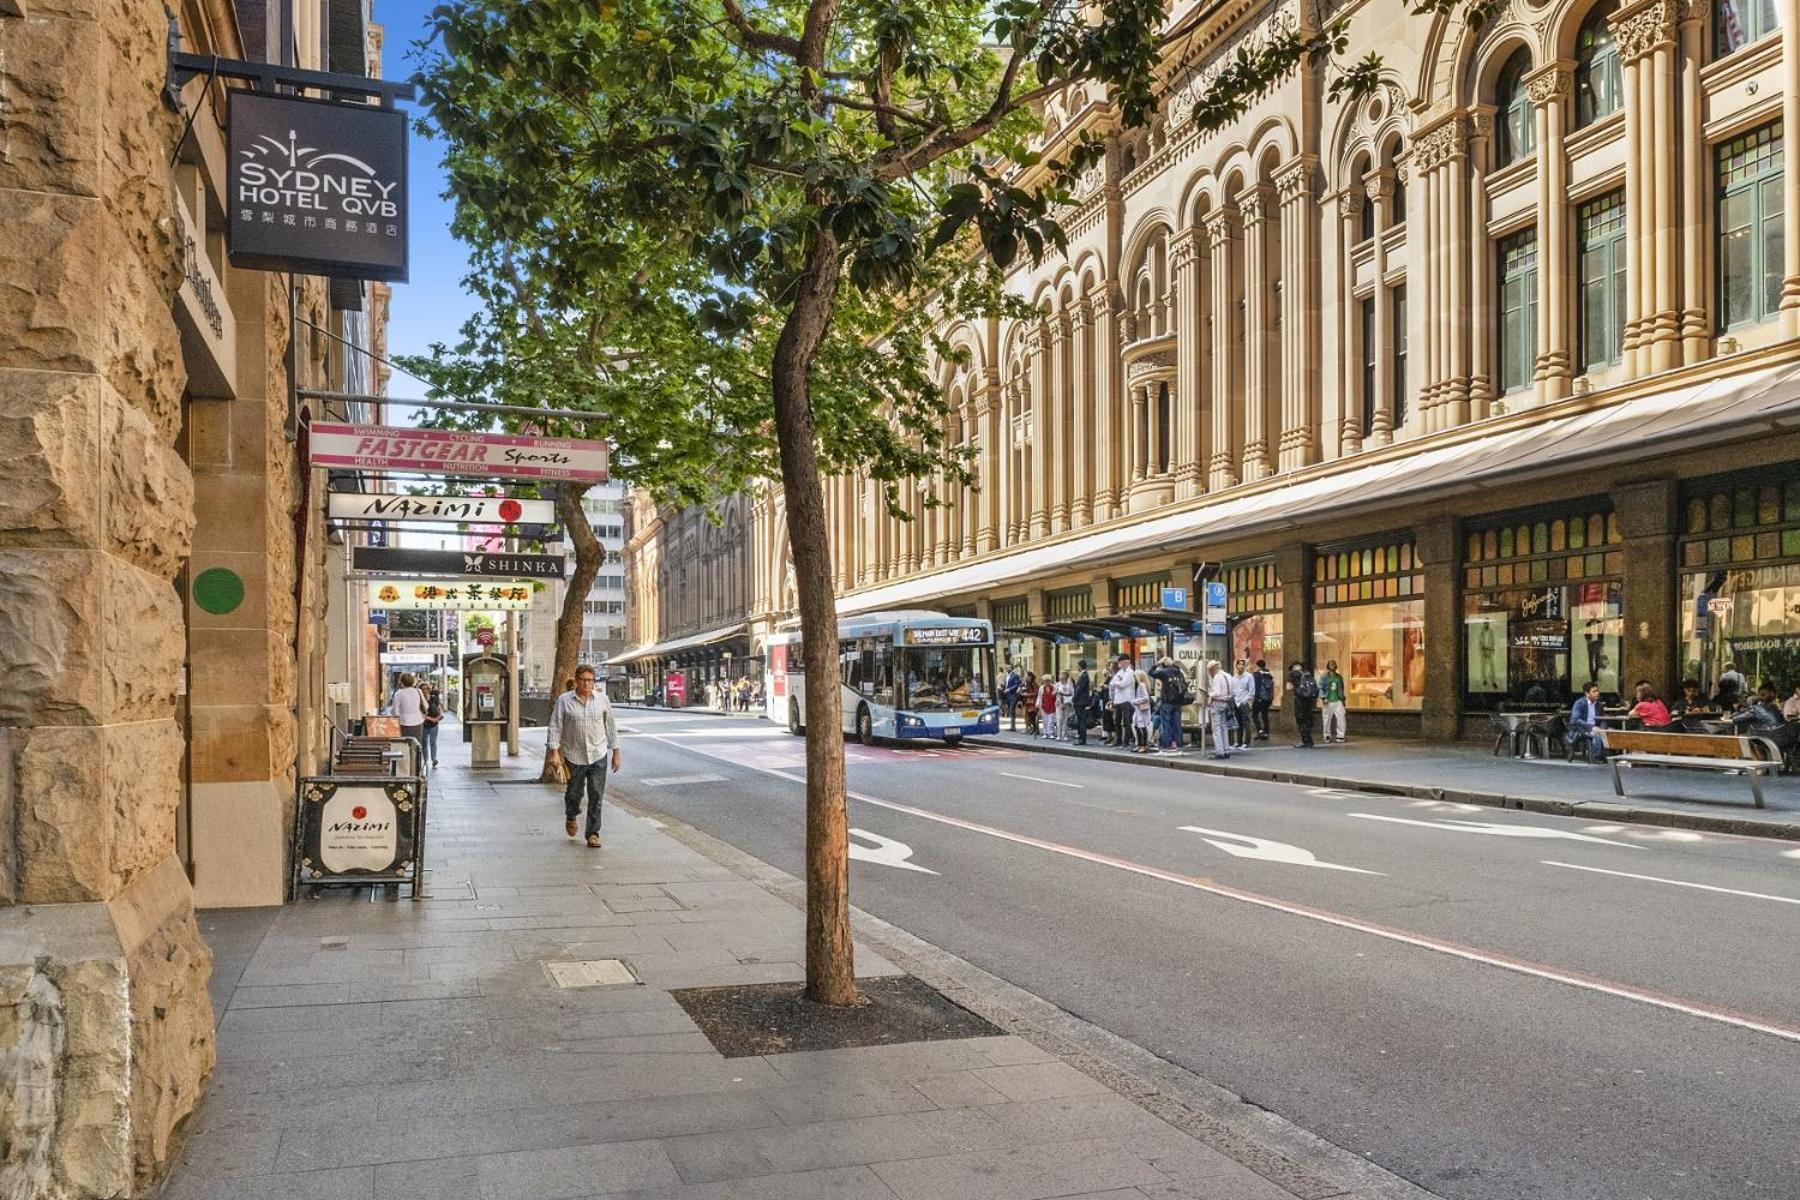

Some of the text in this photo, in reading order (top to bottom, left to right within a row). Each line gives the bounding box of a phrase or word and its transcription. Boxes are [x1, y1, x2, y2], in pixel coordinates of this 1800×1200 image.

[240, 162, 397, 199] SYDNEY
[240, 185, 397, 217] HOTEL QVB
[353, 428, 572, 449] SWIMMING CYCLING RUNNING
[355, 437, 572, 464] FASTGEAR Sports
[354, 457, 570, 477] HEALTH NUTRITION FITNESS
[488, 559, 559, 573] SHINKA
[1175, 590, 1183, 603] B
[961, 628, 981, 641] 442
